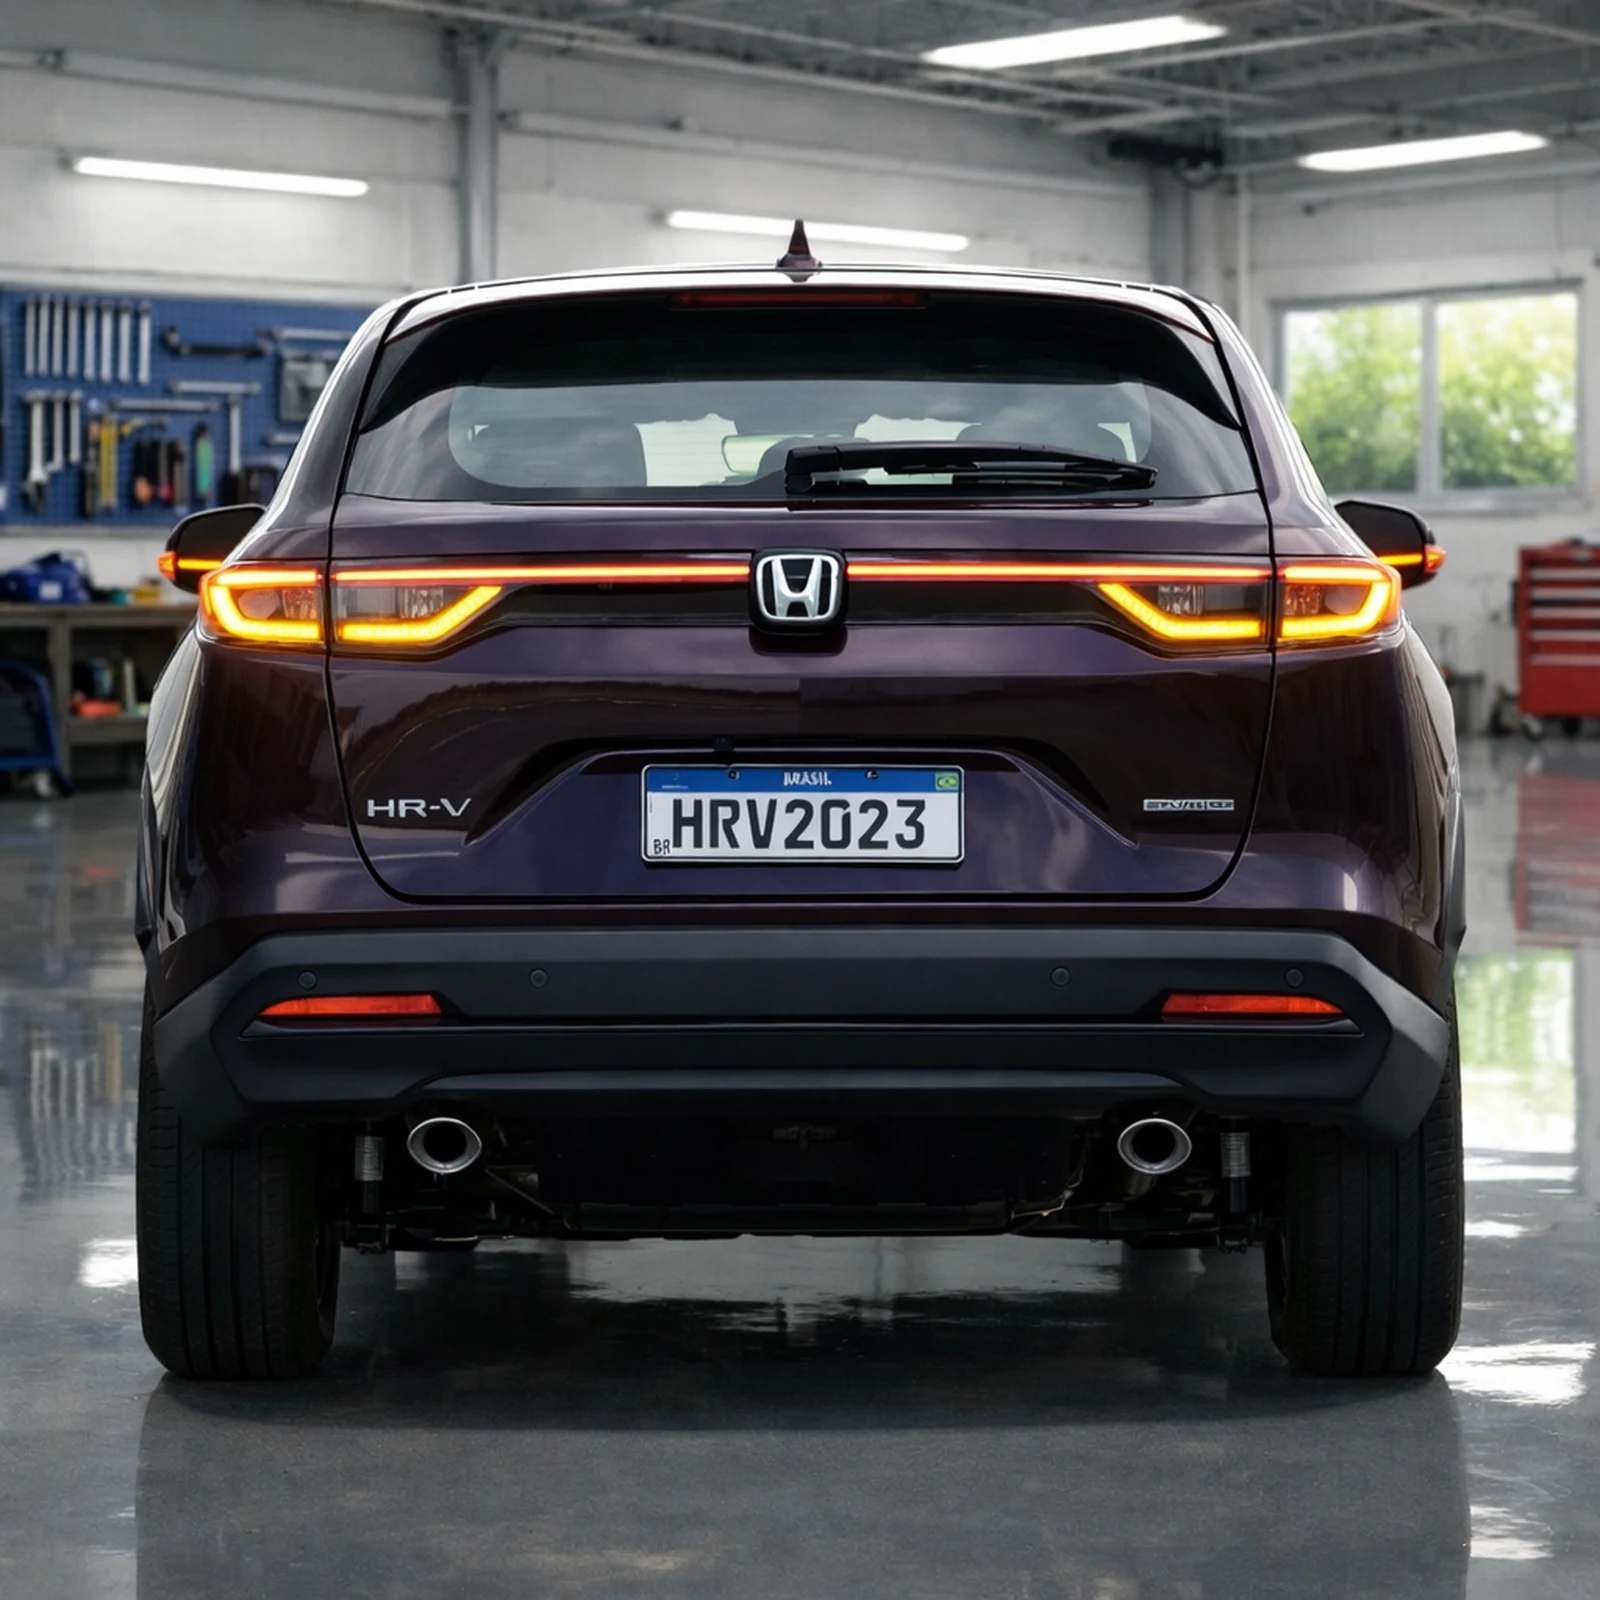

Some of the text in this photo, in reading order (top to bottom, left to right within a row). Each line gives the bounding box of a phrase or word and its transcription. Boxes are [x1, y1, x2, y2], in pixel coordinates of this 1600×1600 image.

[366, 797, 472, 818] HR-V
[673, 798, 926, 850] HRV2023
[653, 838, 671, 855] BR
